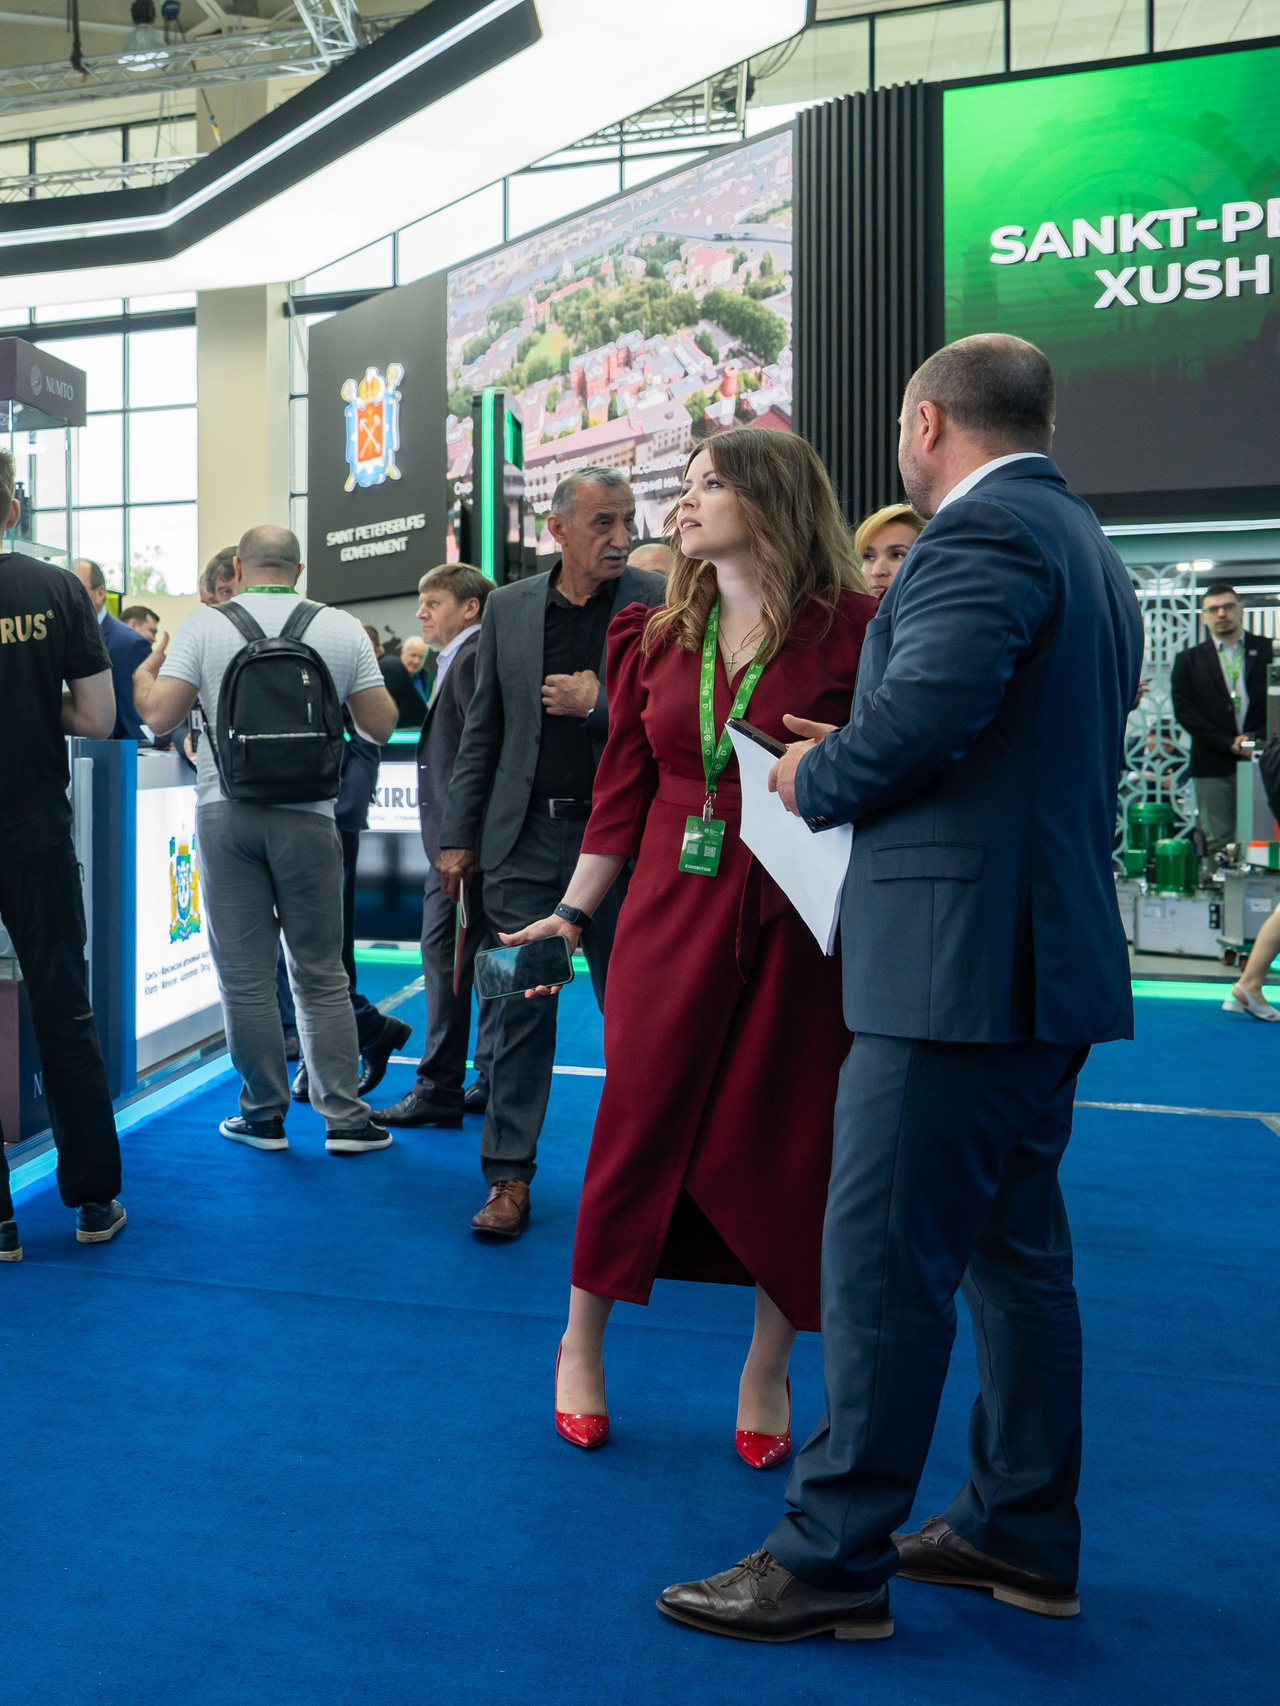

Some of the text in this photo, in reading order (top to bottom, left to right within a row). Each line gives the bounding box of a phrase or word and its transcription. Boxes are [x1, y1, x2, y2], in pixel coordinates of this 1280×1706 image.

[1094, 254, 1270, 309] XUSH
[45, 375, 74, 401] NUMTO
[684, 863, 712, 873] EXHIBITOR
